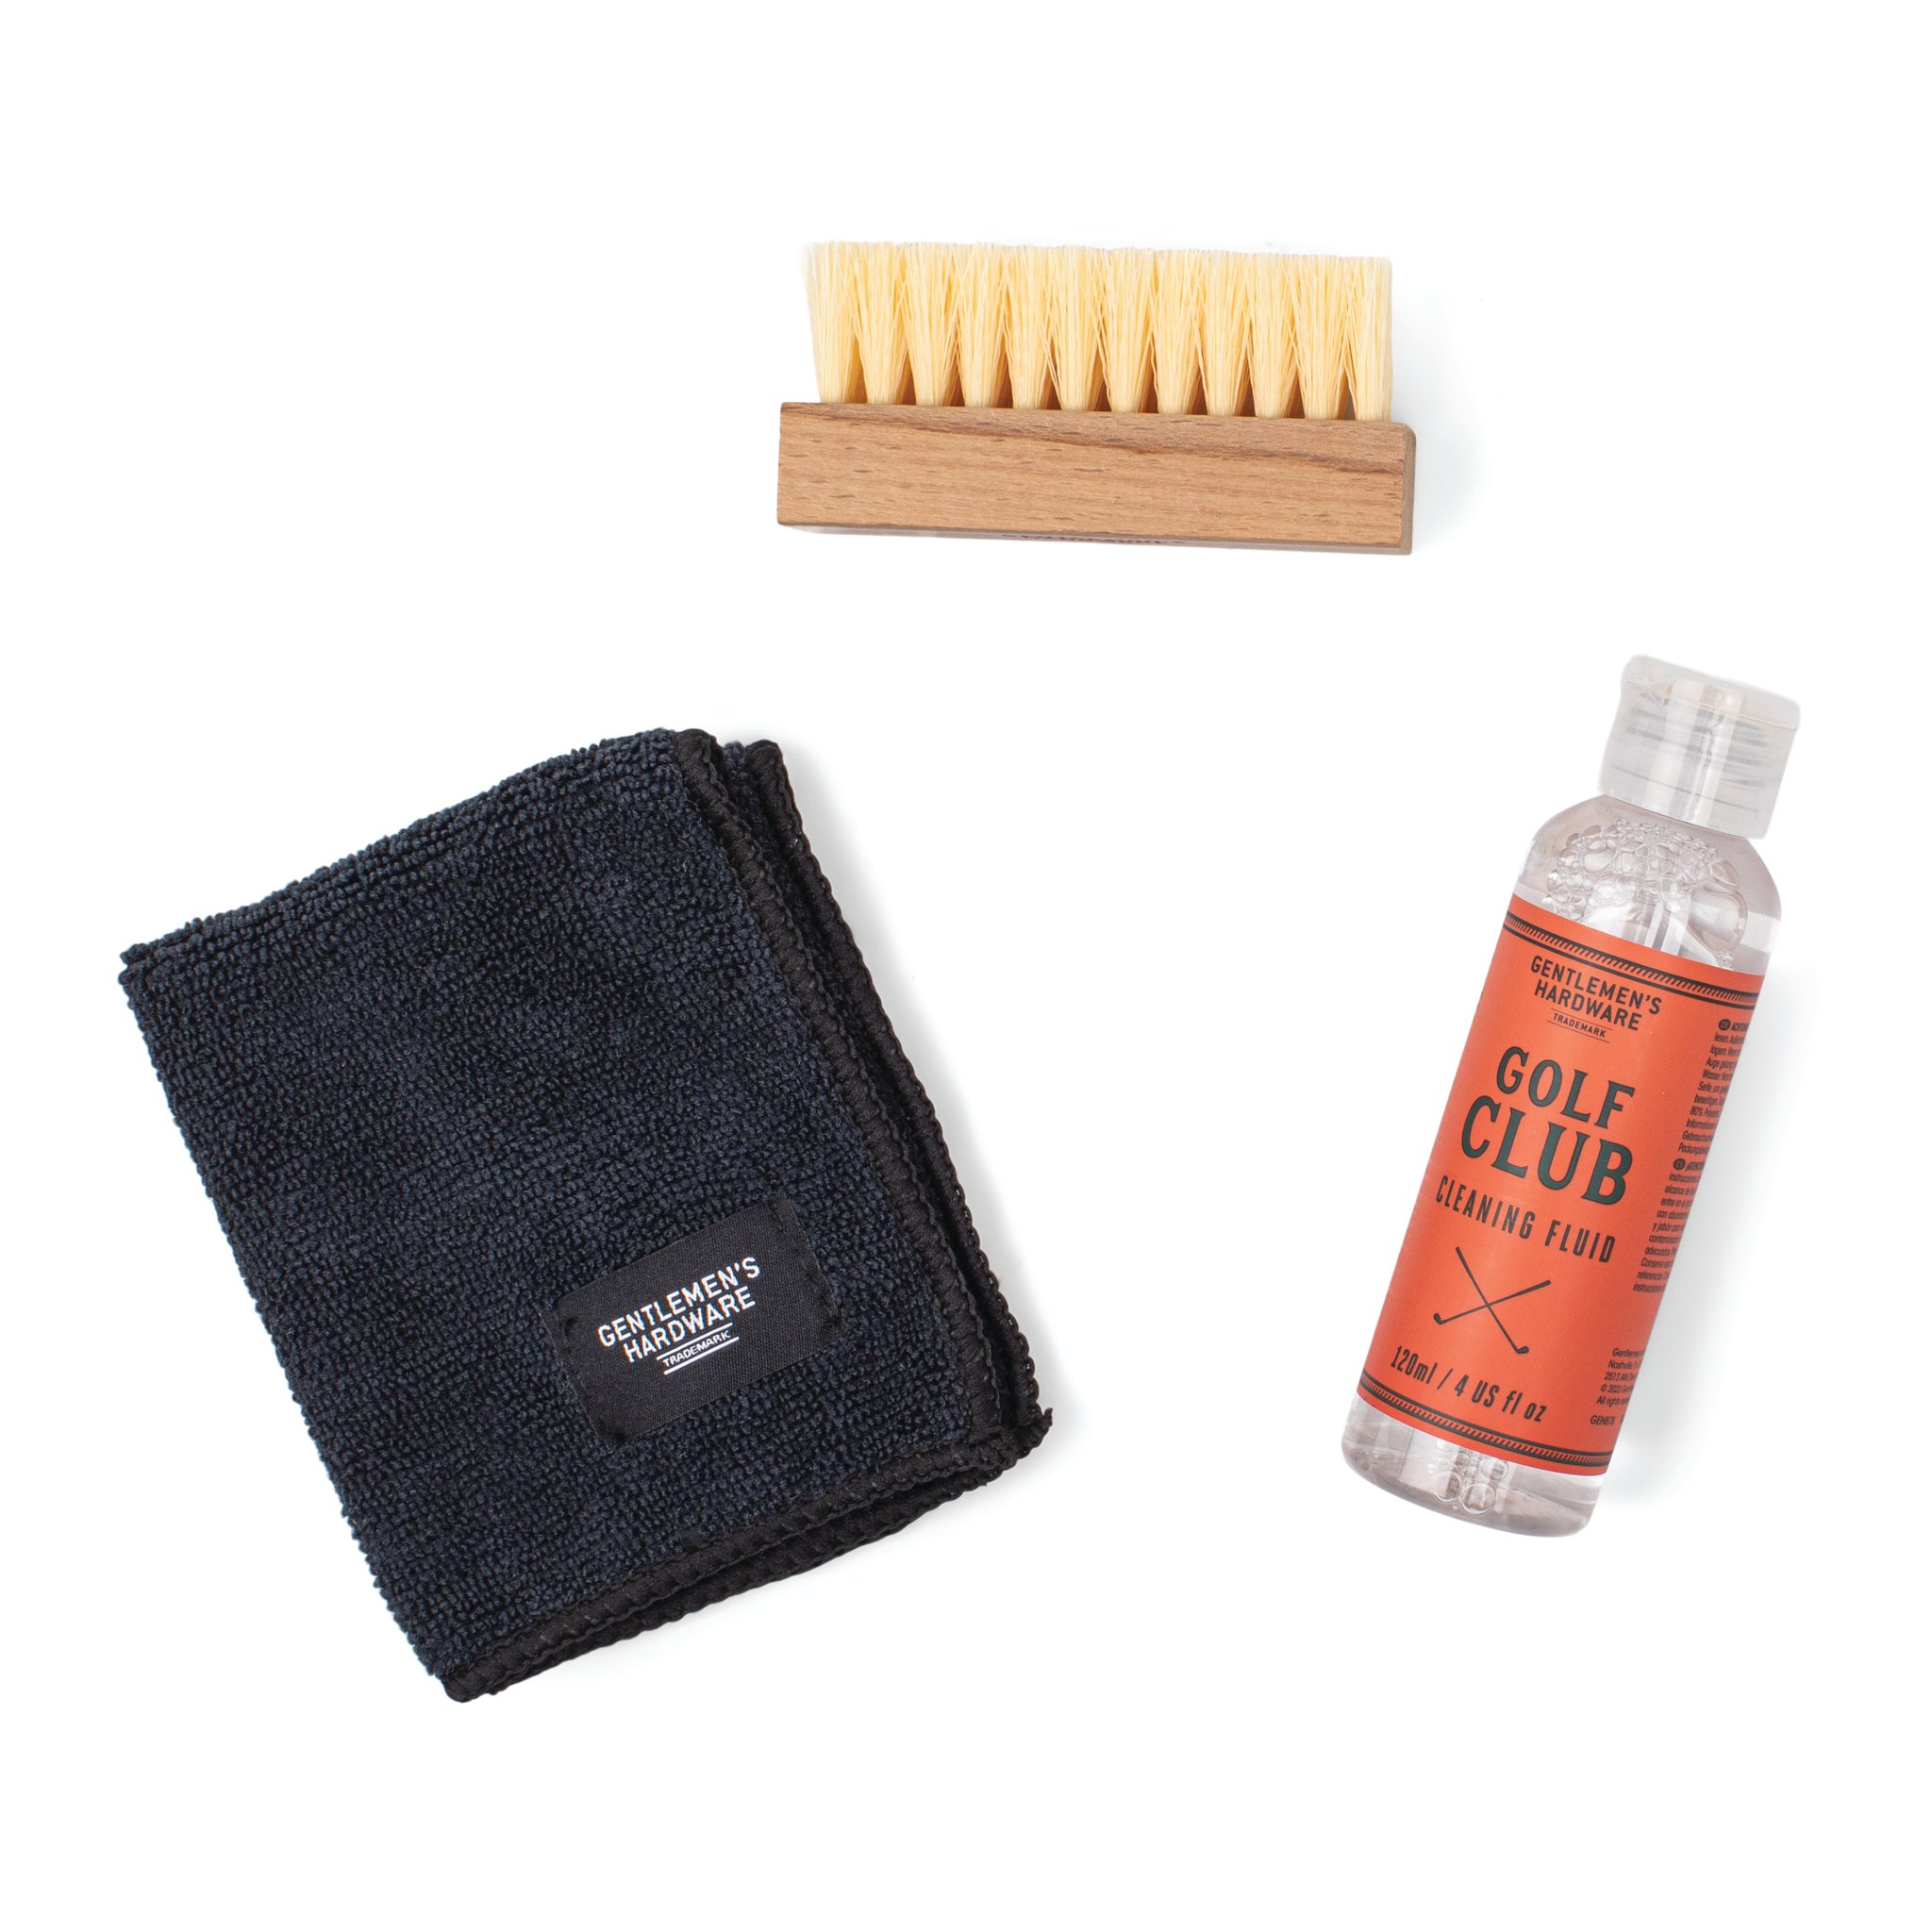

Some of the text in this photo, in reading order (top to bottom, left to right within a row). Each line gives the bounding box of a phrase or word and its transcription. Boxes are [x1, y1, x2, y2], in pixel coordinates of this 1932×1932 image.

[1530, 955, 1662, 1015] GENTLEMEN'S
[1534, 979, 1642, 1031] HARDWARE
[1553, 1012, 1607, 1038] TRADEMARK
[1496, 1046, 1636, 1129] GOLF
[1461, 1095, 1633, 1206] CLUB
[1436, 1174, 1616, 1264] CLEANING FLUID
[597, 1257, 760, 1347] GENTLEMEN'S
[623, 1285, 757, 1363] HARDWARE
[662, 1329, 731, 1368] TRADEMARK
[1391, 1345, 1547, 1422] 120ml / 4 US fl oz
[1596, 1395, 1607, 1405] All
